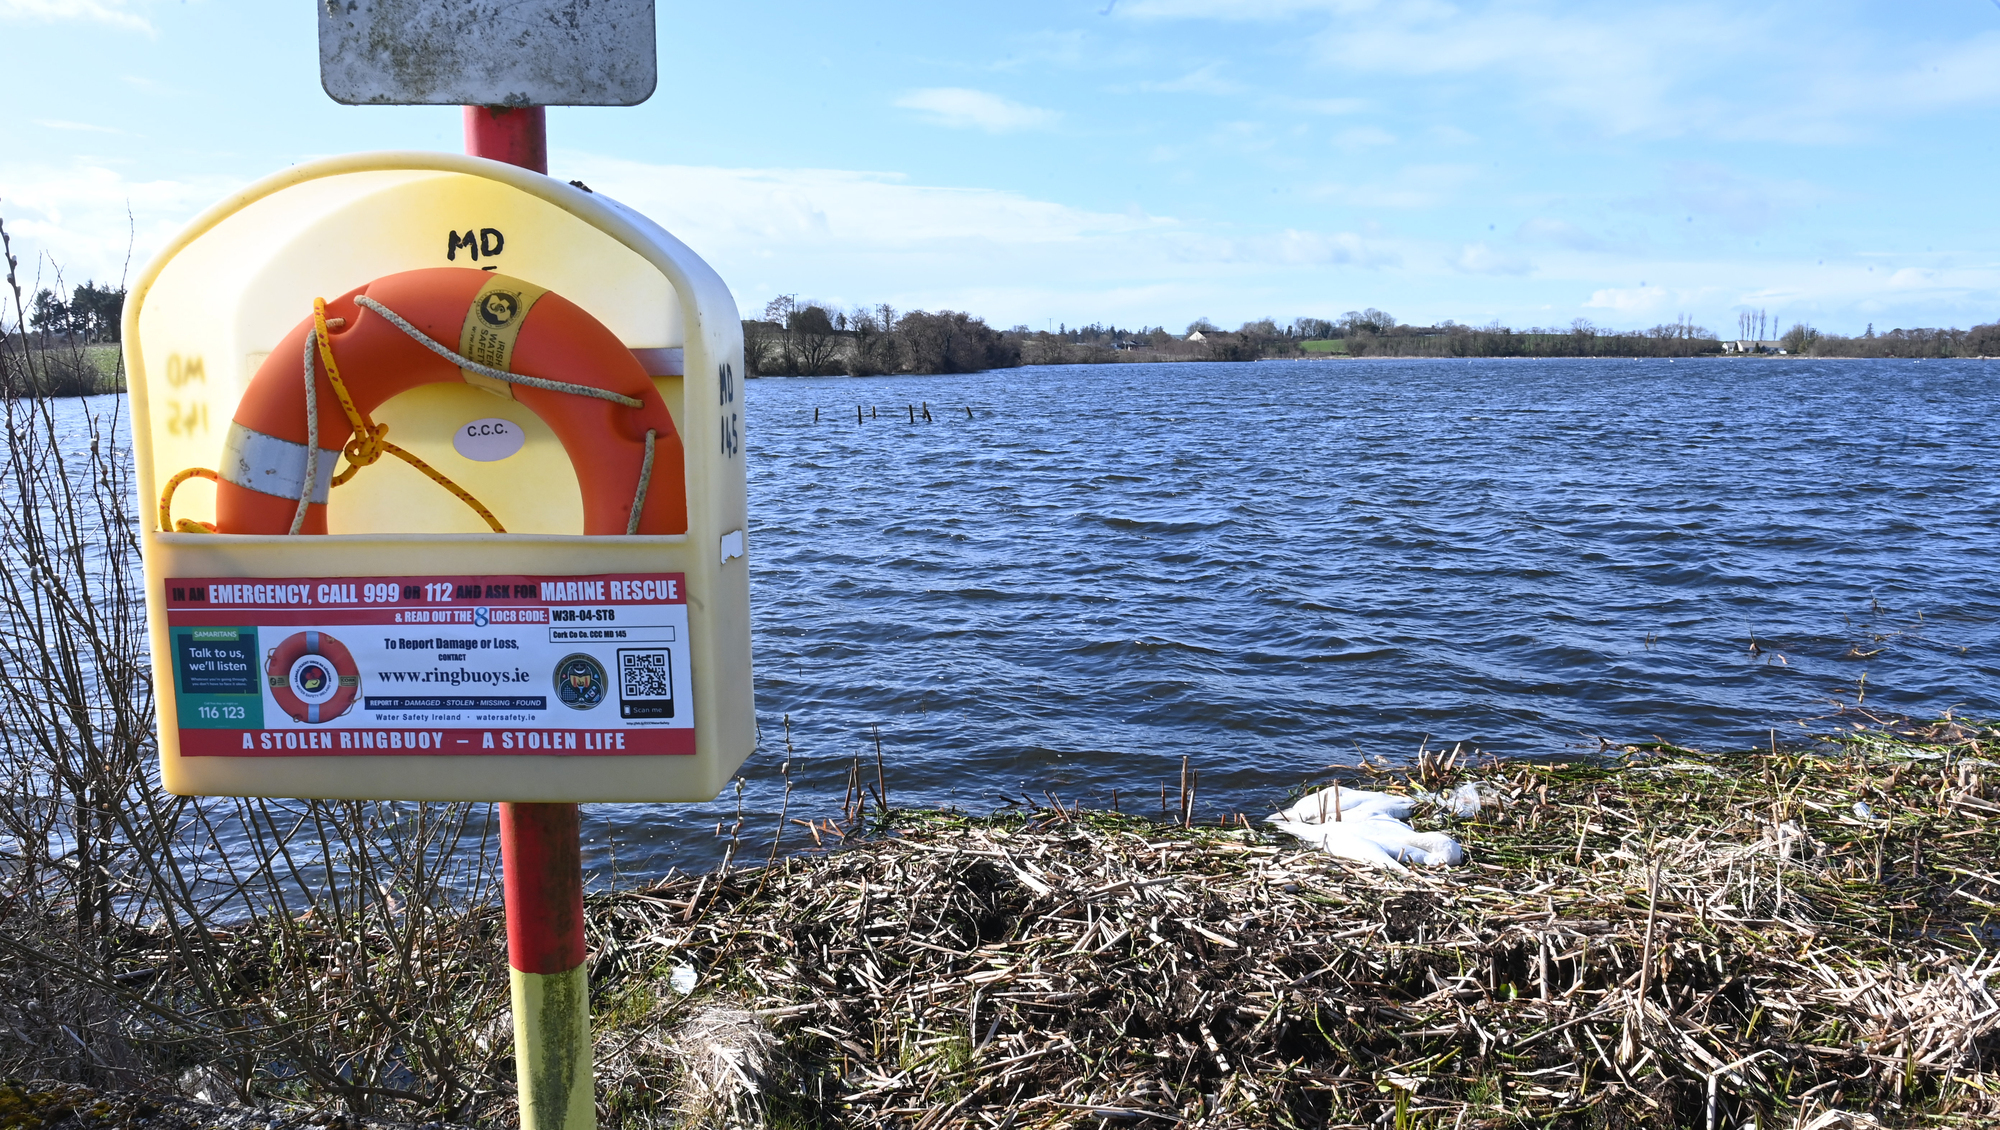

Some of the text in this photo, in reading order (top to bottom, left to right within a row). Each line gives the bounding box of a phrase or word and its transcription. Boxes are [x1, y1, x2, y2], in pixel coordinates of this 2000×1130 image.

[447, 228, 504, 261] MD
[477, 328, 489, 366] SAFETY
[486, 333, 498, 367] WATER
[495, 340, 506, 367] IRISH
[719, 363, 734, 406] MD
[467, 423, 508, 437] C.C.C.
[721, 413, 738, 459] 145
[172, 580, 678, 605] IN AN EMERGENCY, CALL 999 OR 112 AND ASK FOR MARINE RESCUE
[404, 611, 430, 623] READ
[432, 611, 452, 623] OUT
[454, 611, 472, 622] THE
[491, 611, 517, 622] LOC8
[519, 610, 548, 622] CODE:
[552, 609, 615, 622] W3R-04-ST8
[553, 631, 568, 639] Cork
[604, 630, 614, 638] MD
[615, 630, 627, 638] 145
[384, 638, 520, 650] To Report Damage or Loss,
[189, 647, 245, 659] Talk to us,
[438, 653, 467, 661] CONTACT
[217, 661, 247, 671] listen
[378, 667, 530, 686] www.ringbuoys.ie
[198, 706, 246, 719] 116 123
[375, 713, 536, 722] Water Safety Ireland watersafety.ie
[242, 732, 254, 749] A
[260, 732, 332, 750] STOLEN
[340, 731, 443, 749] RINGBUOY
[482, 732, 494, 749] A
[501, 731, 577, 749] STOLEN
[584, 732, 626, 750] LIFE
